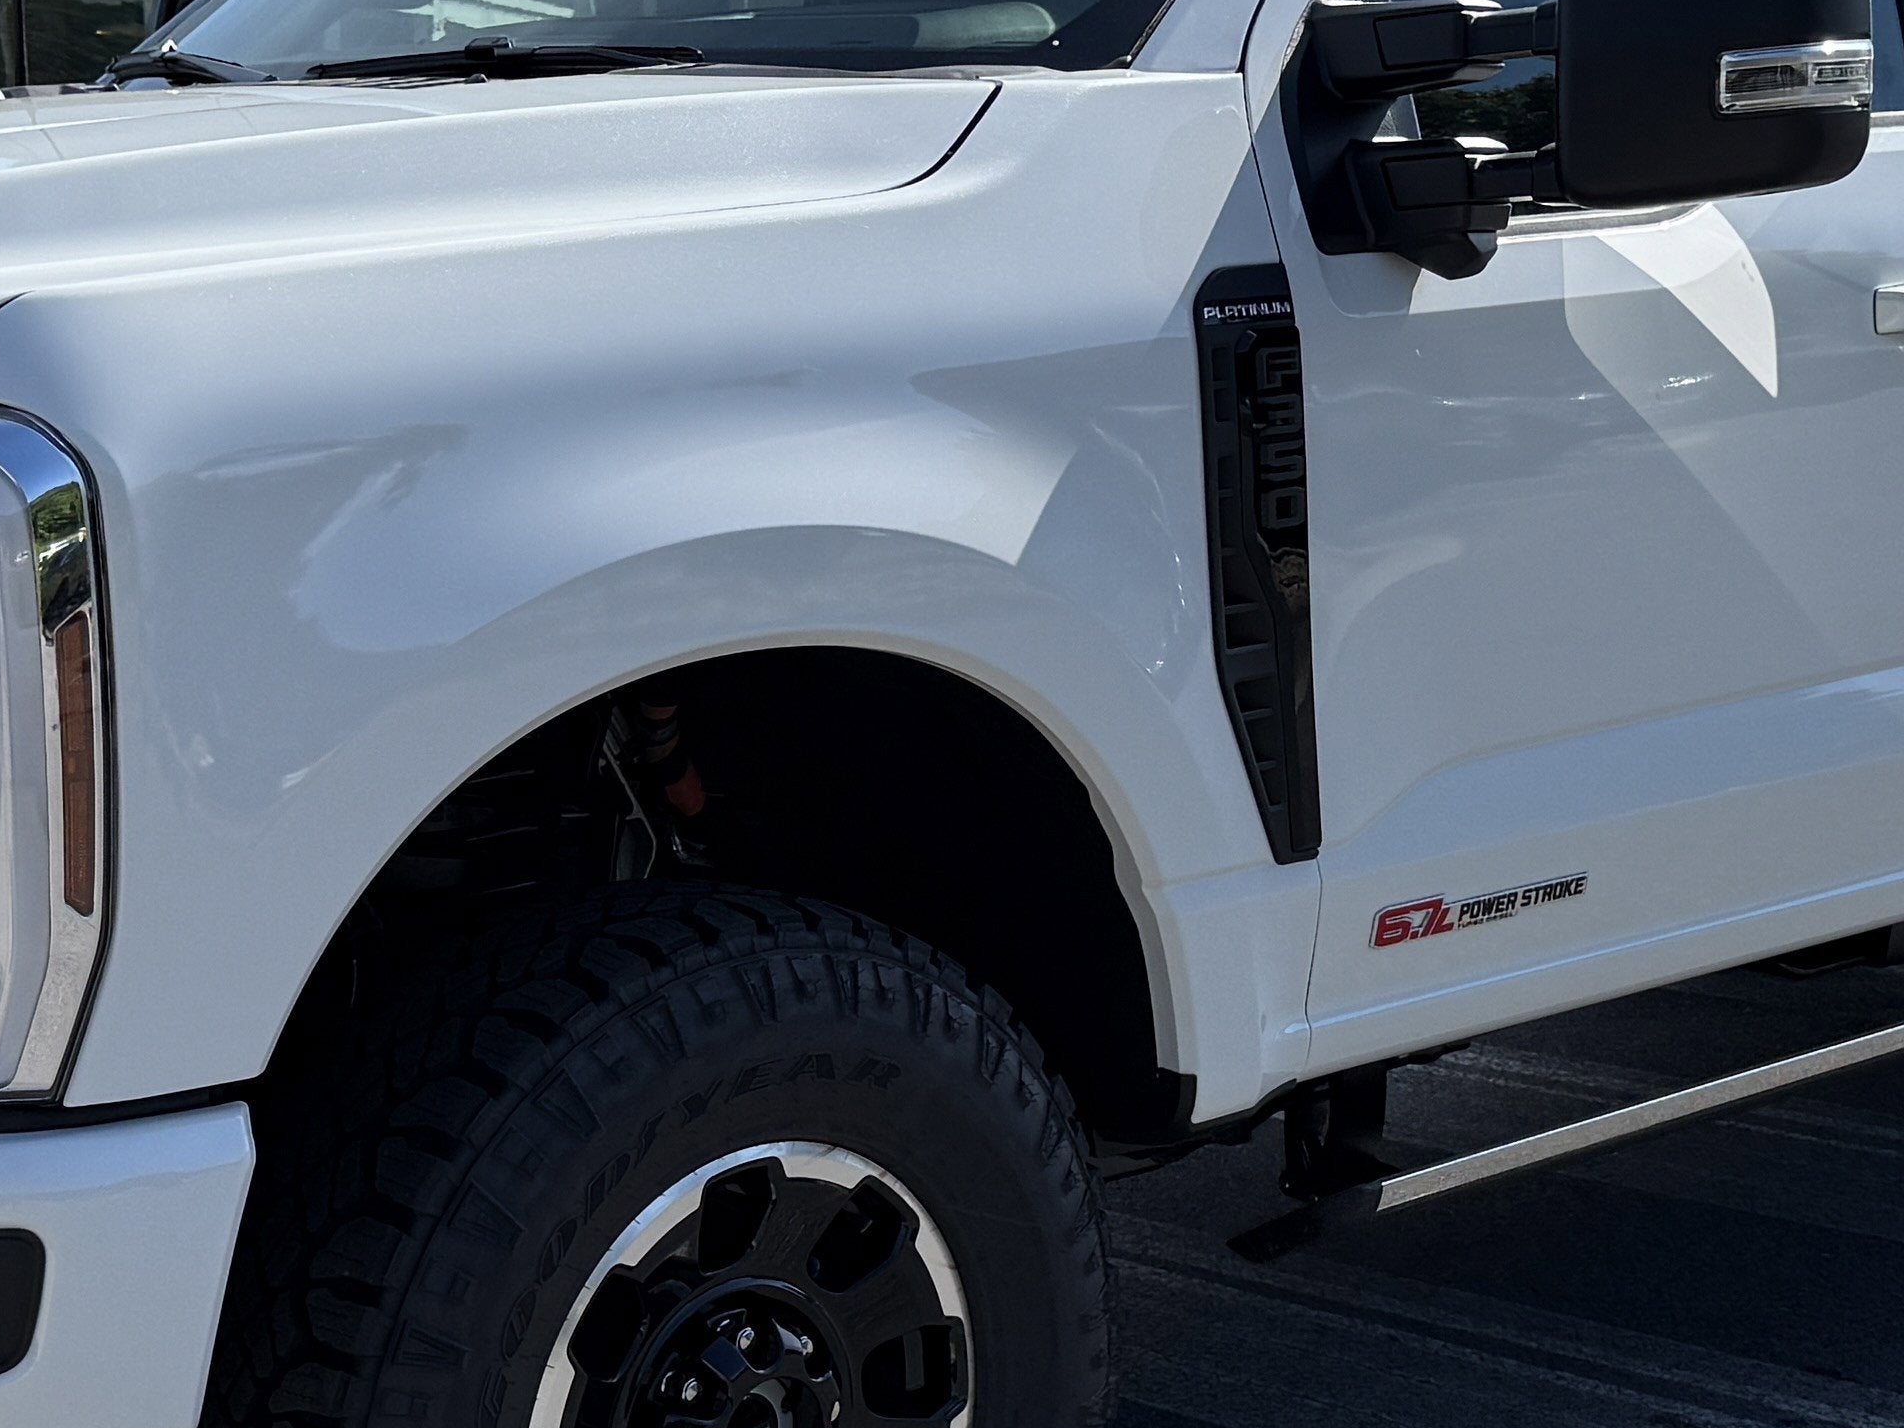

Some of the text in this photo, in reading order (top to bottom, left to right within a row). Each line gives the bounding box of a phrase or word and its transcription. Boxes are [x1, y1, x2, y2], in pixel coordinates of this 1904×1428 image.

[1203, 302, 1292, 321] PLATINUM
[1374, 876, 1588, 948] 6.7L POWER STROKE
